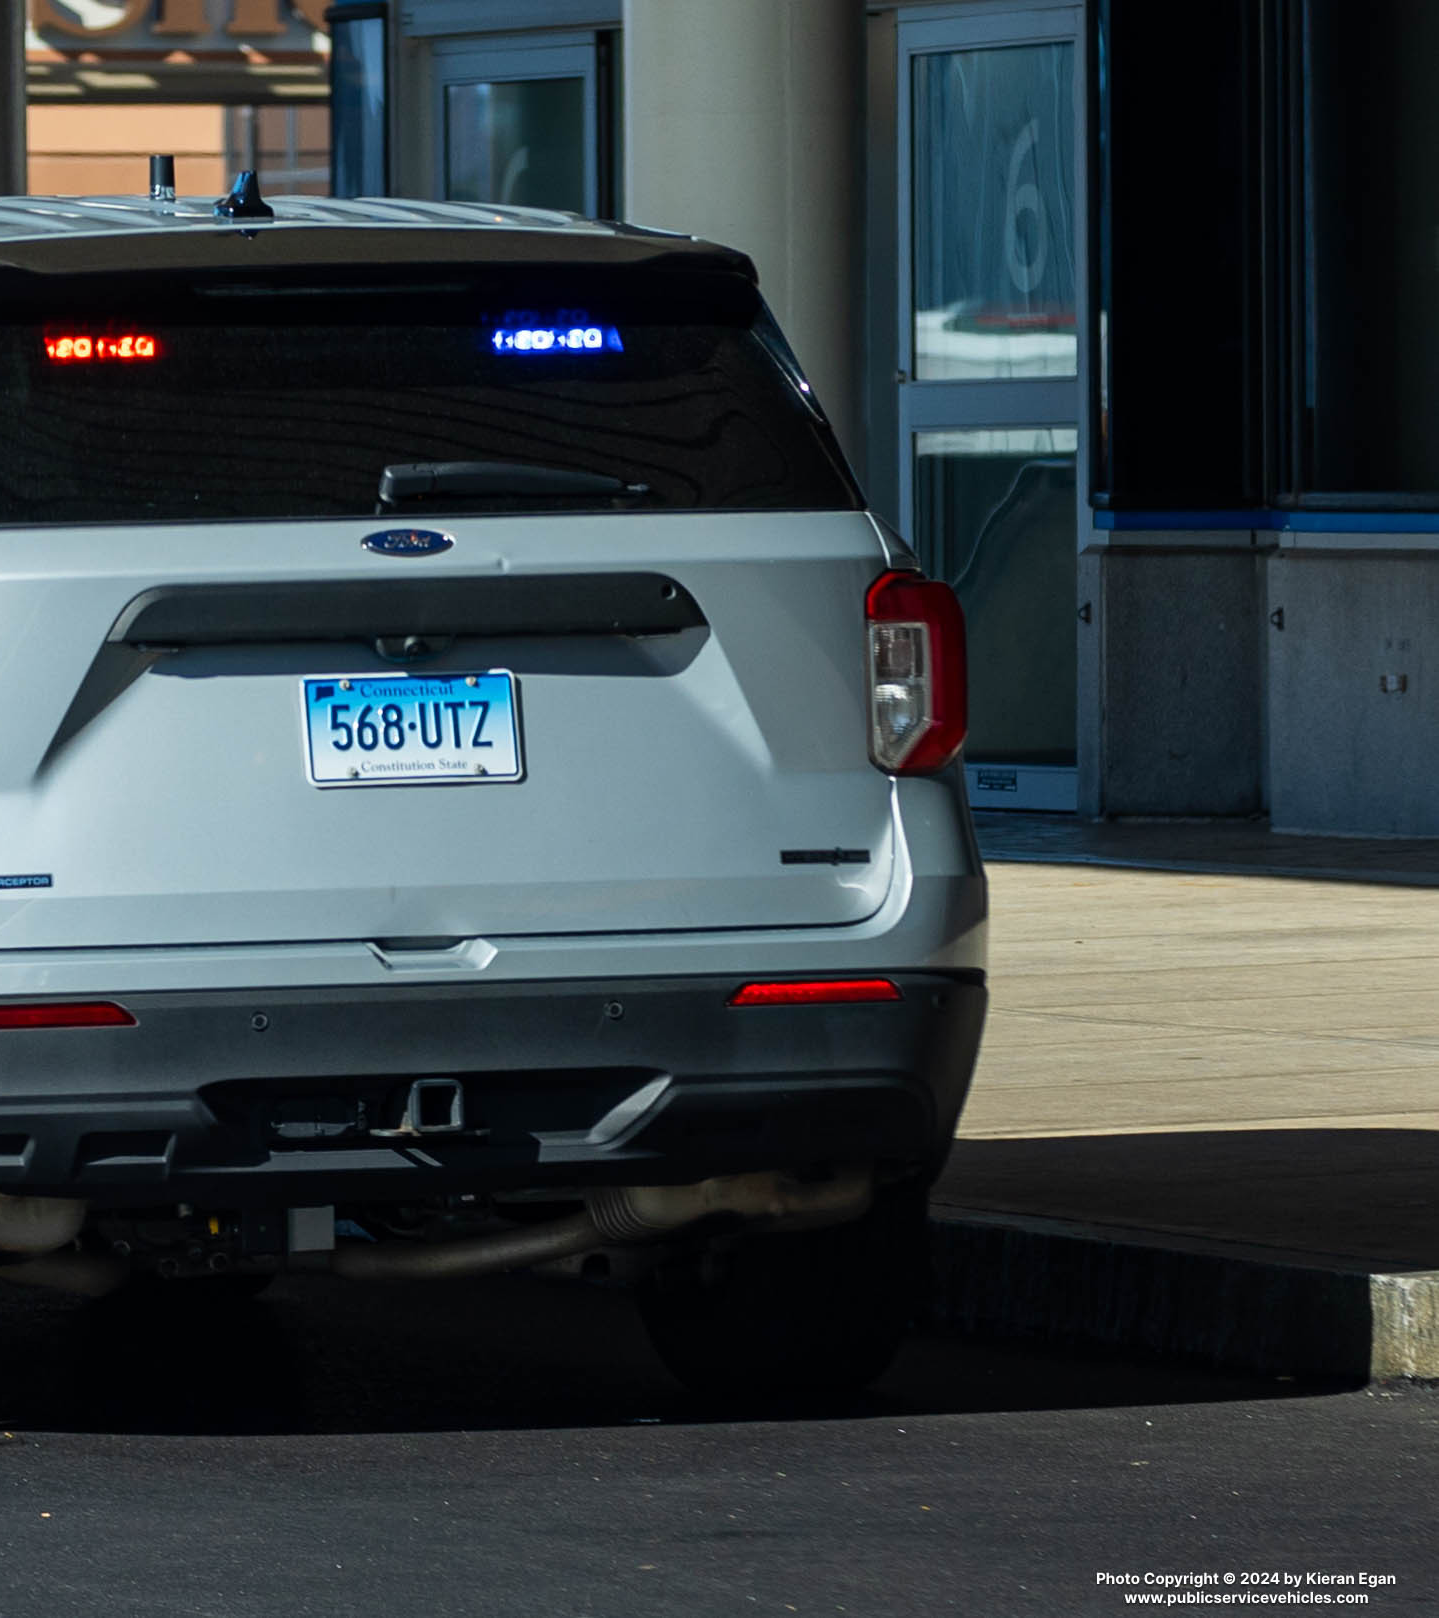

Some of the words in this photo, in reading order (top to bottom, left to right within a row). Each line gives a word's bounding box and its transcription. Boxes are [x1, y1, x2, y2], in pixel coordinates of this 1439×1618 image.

[1006, 117, 1047, 293] 6
[360, 682, 456, 698] Connecticut
[360, 759, 436, 773] Constitution
[439, 758, 469, 770] State
